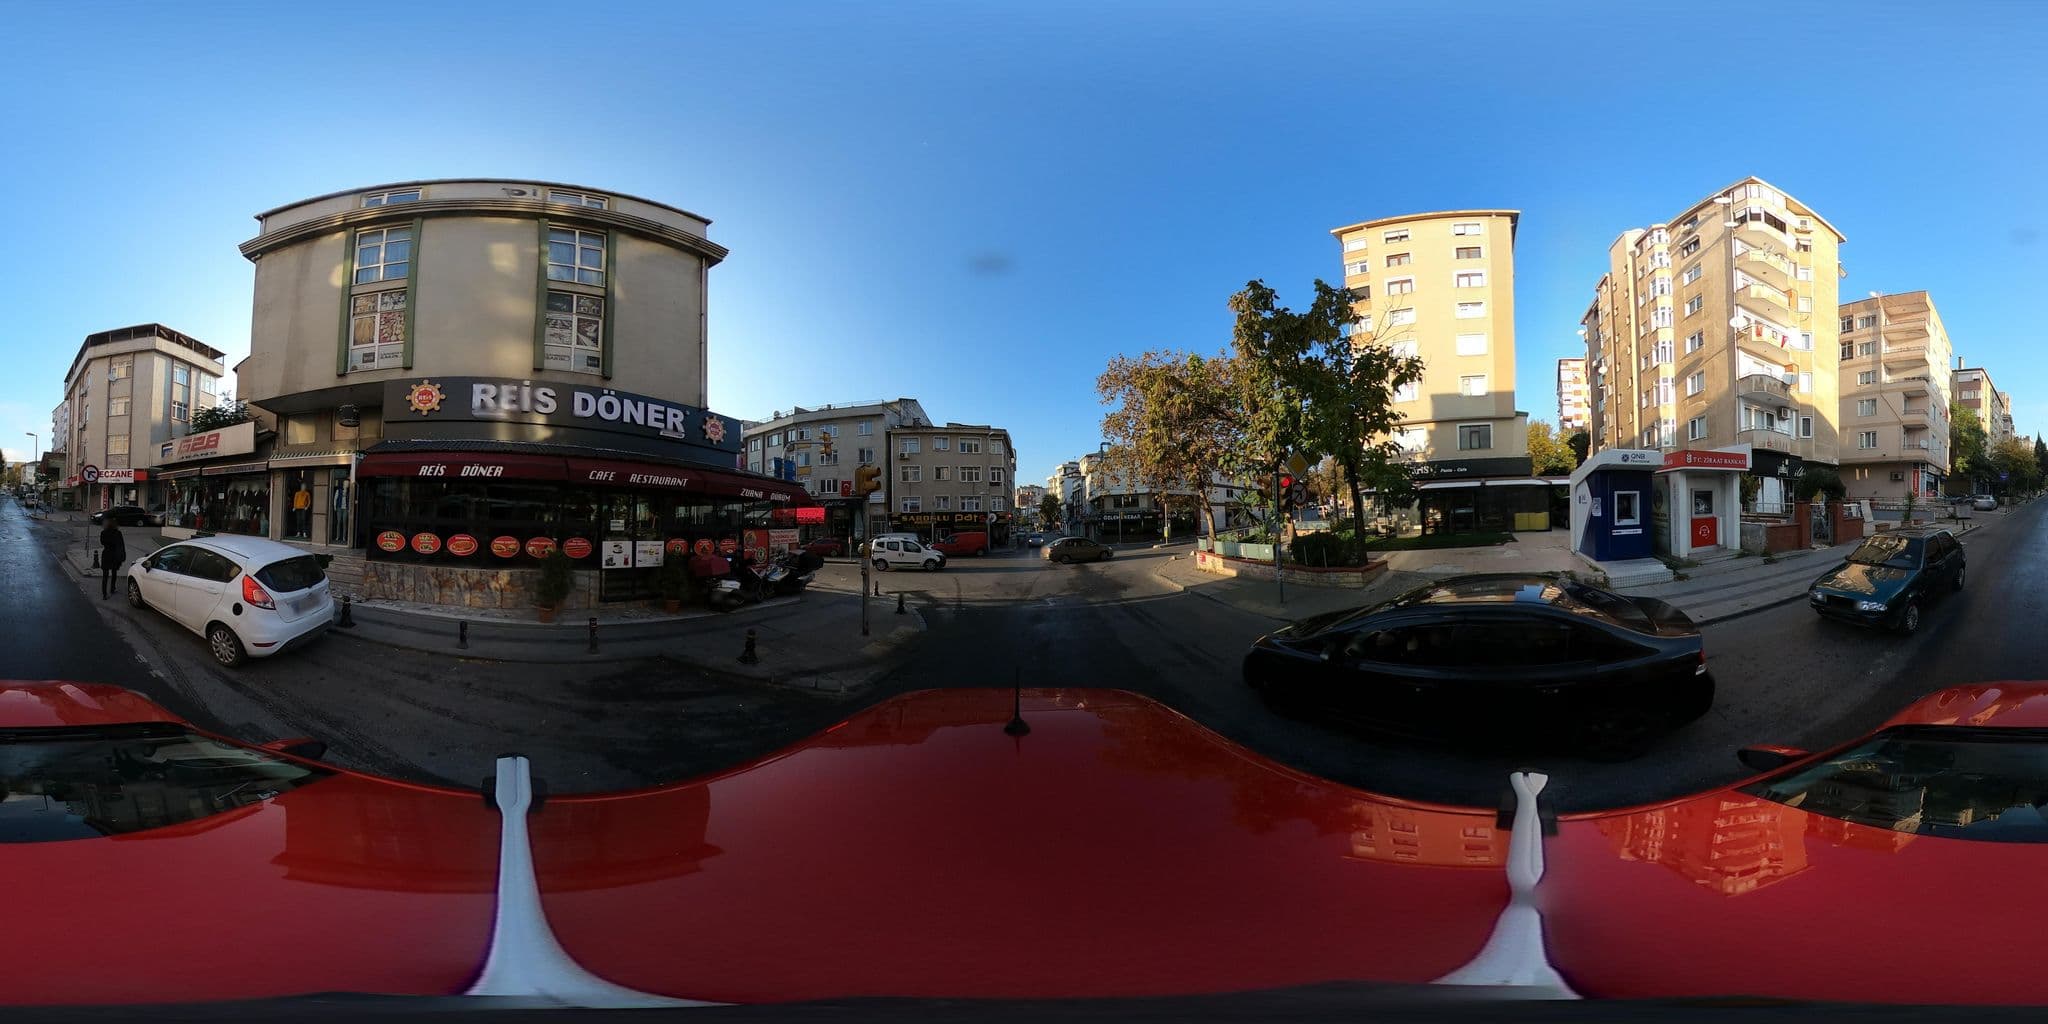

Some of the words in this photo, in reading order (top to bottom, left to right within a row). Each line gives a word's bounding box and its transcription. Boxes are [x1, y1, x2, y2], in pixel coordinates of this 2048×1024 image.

[573, 389, 685, 433] DÖNER
[99, 470, 133, 478] ECZANE
[460, 463, 504, 477] DÖNER
[588, 470, 616, 481] CAFE
[629, 473, 689, 487] RESTAURANT
